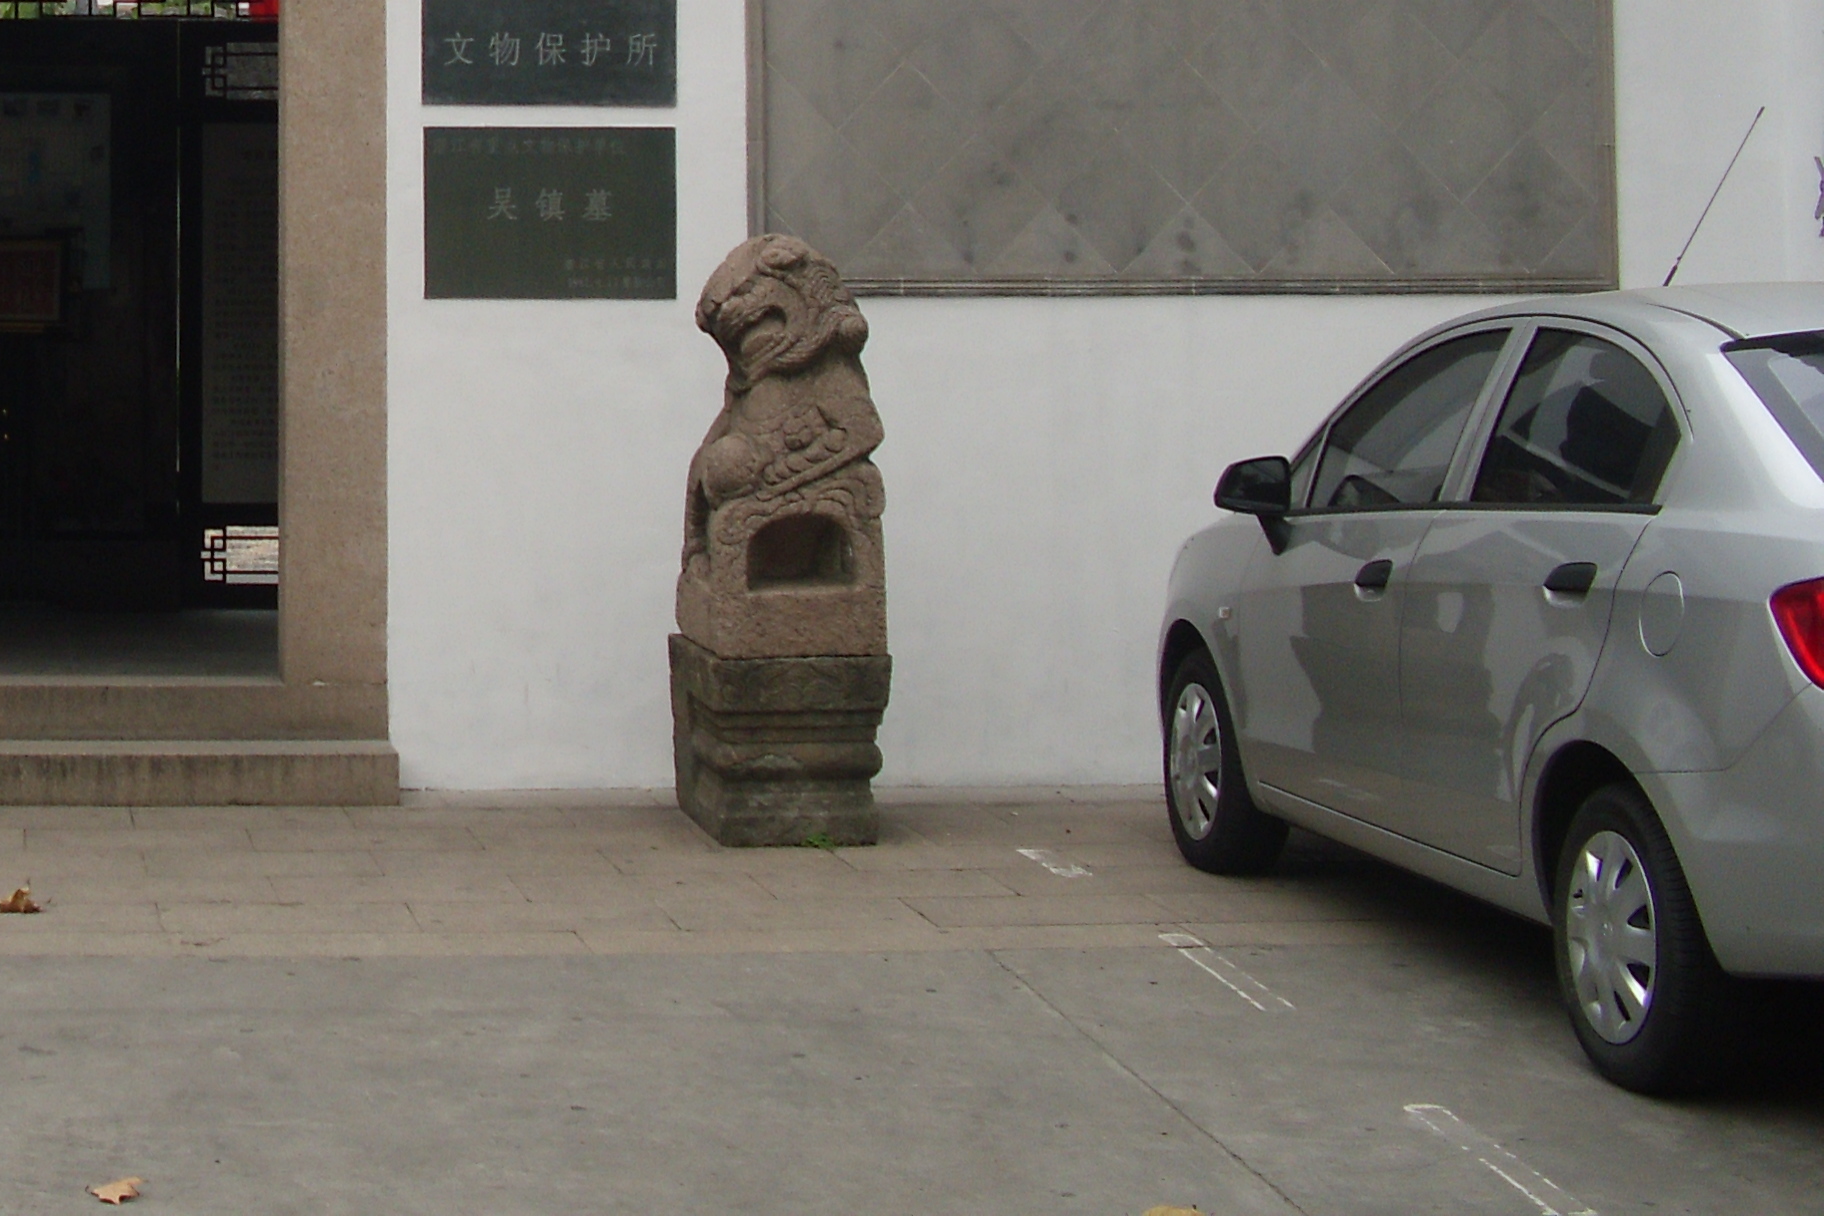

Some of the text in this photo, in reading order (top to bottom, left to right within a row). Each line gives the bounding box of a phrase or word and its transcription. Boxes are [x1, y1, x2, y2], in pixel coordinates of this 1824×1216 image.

[443, 31, 658, 67] 文物保护所
[487, 187, 613, 222] 吴镇墓
